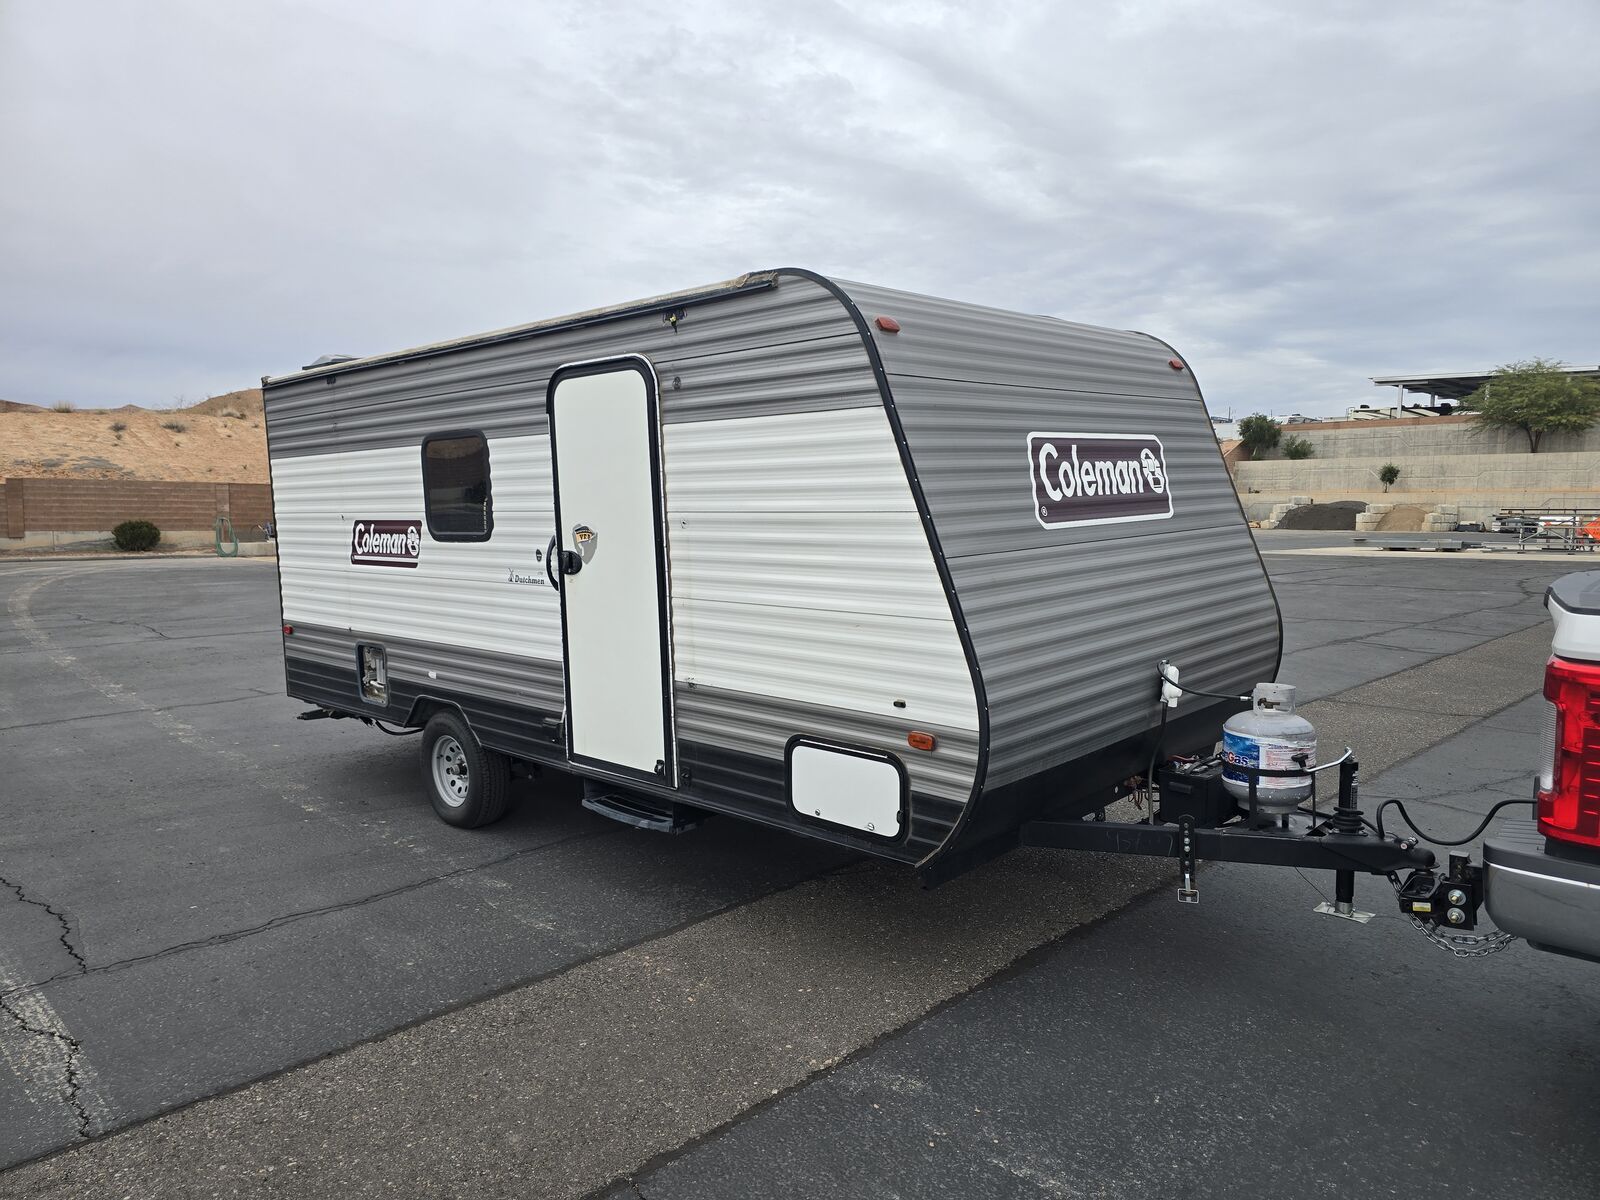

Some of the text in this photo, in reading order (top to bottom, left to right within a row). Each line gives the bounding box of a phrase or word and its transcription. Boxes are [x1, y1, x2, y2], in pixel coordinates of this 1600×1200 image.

[1038, 442, 1144, 502] Coleman
[354, 523, 406, 555] Coleman
[514, 574, 545, 585] Dutchmen
